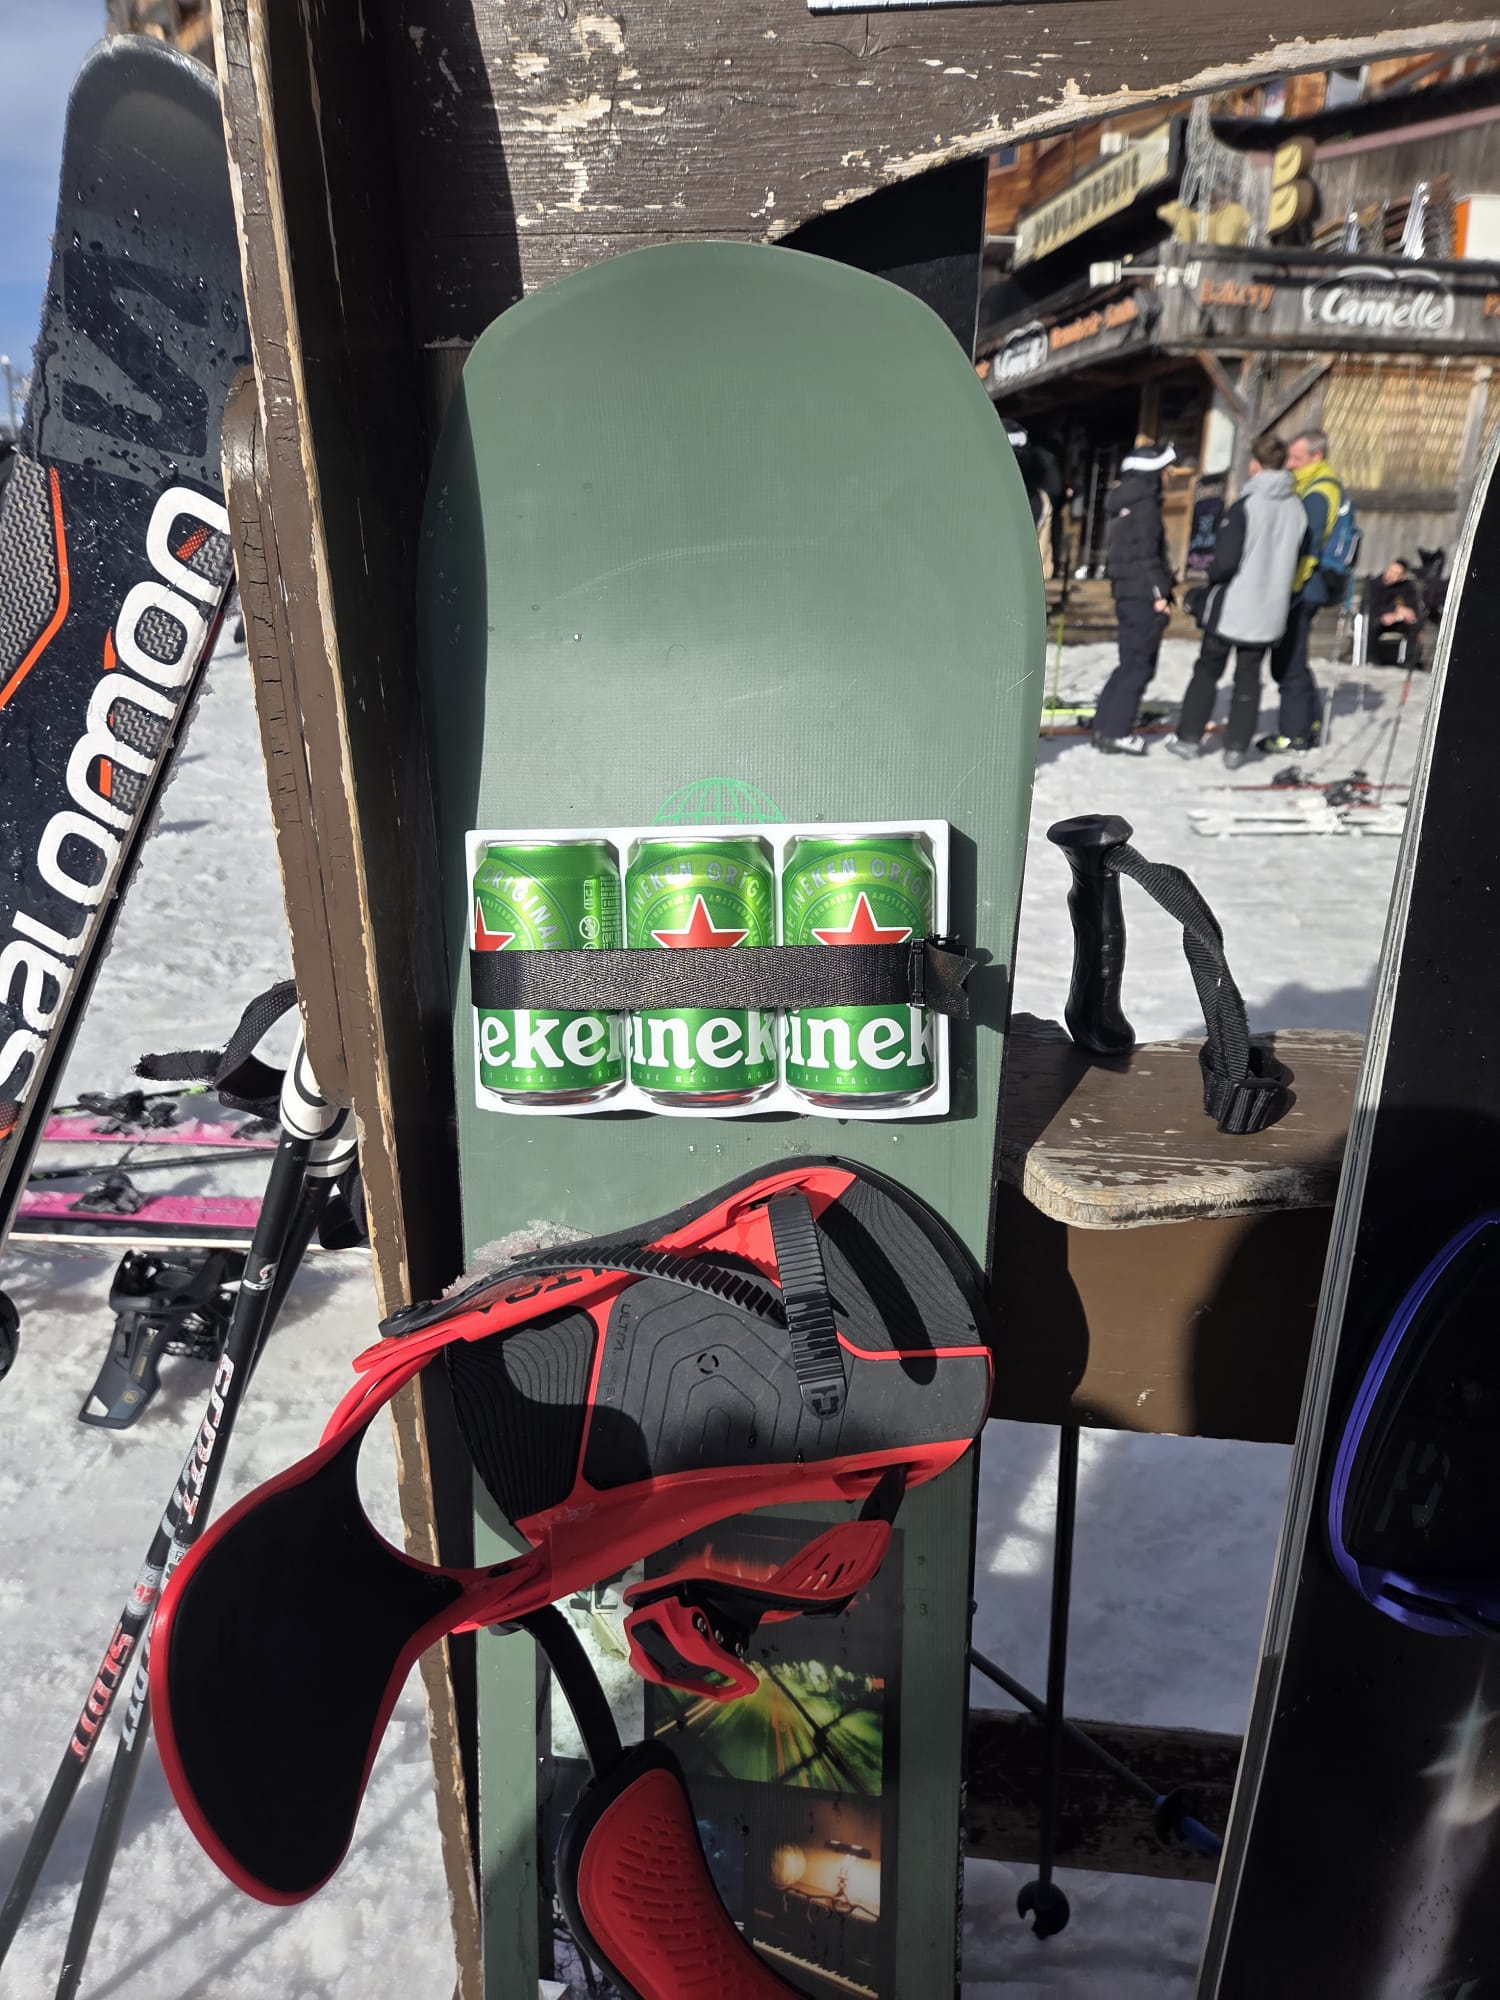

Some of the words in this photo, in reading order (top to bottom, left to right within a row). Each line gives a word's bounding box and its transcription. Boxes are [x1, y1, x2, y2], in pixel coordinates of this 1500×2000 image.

[1320, 286, 1445, 329] Cannelle
[182, 1353, 234, 1526] SCOTT
[71, 1632, 134, 1763] SCOTT
